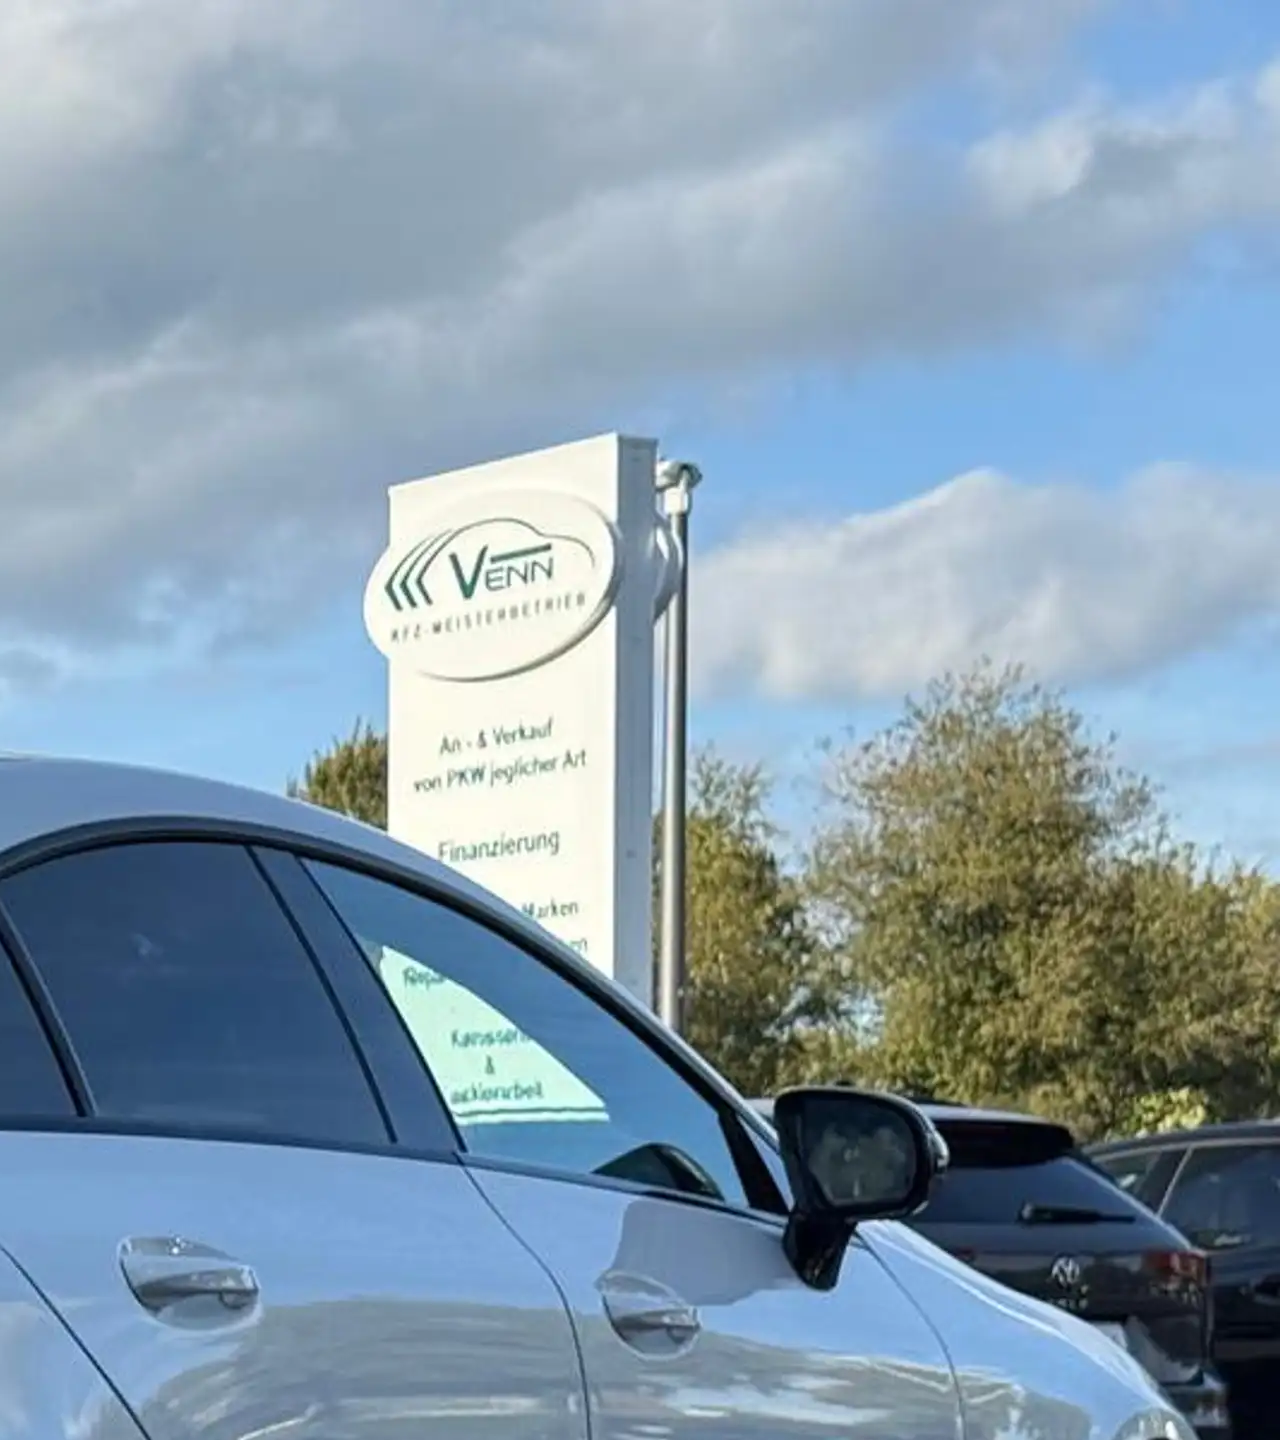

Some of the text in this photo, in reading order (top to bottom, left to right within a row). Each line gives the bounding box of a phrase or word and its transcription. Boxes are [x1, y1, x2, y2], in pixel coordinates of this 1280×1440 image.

[448, 544, 554, 600] VENN
[492, 715, 554, 746] Verkauf
[413, 748, 587, 793] von PKW jeglicher Art
[438, 830, 560, 862] Finanzierung
